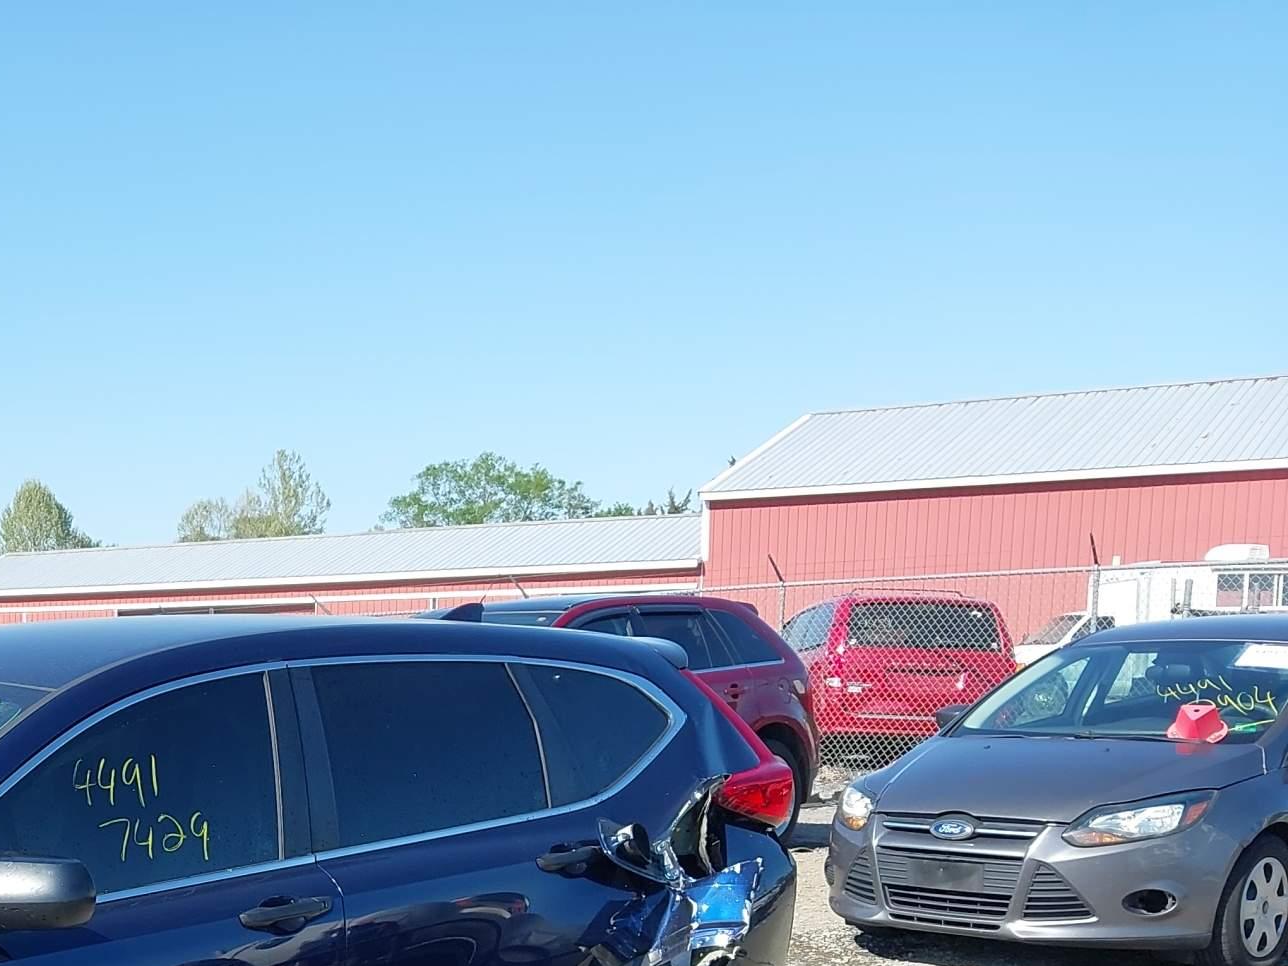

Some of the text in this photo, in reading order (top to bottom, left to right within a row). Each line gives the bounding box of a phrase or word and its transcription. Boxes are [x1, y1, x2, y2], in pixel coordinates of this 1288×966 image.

[1156, 675, 1233, 704] 4491
[73, 754, 159, 808] 4491
[98, 811, 210, 862] 7429
